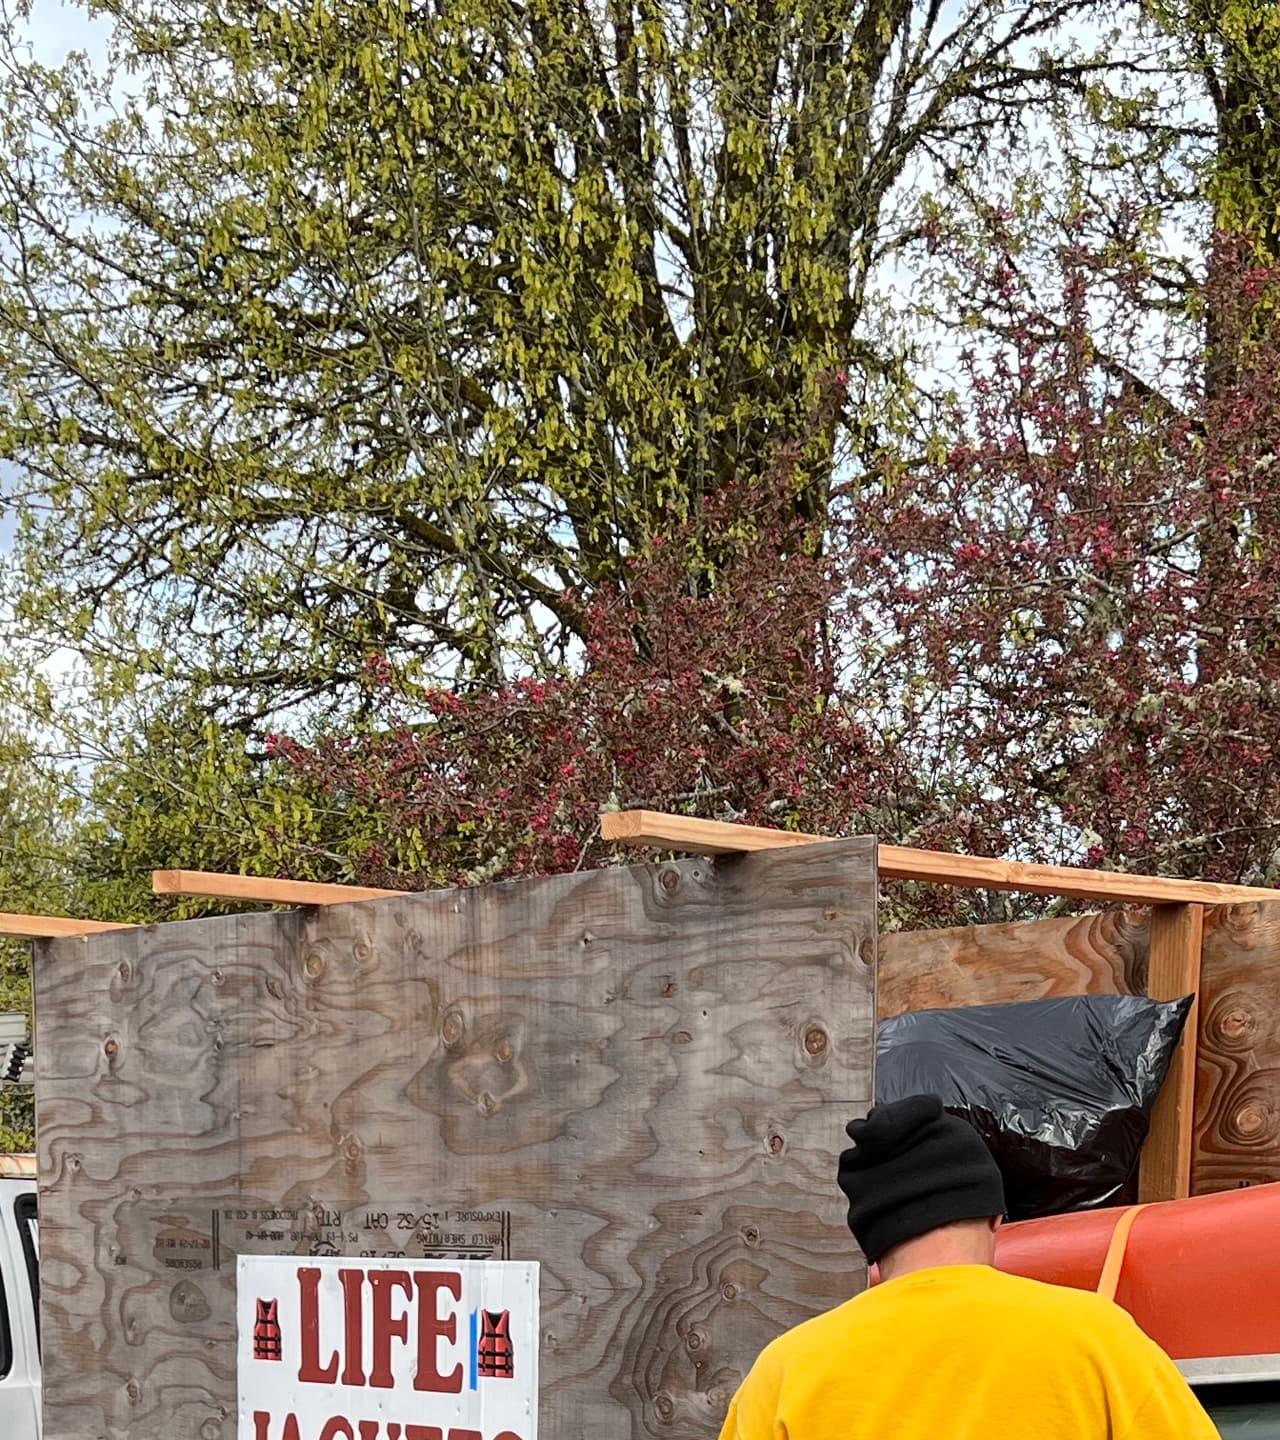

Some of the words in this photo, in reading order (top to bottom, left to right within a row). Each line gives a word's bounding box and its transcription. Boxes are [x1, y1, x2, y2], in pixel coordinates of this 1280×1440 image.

[363, 1213, 389, 1229] CAT
[397, 1213, 439, 1230] 15/32
[455, 1211, 501, 1222] EXPOSURE
[297, 1267, 463, 1394] LIFE
